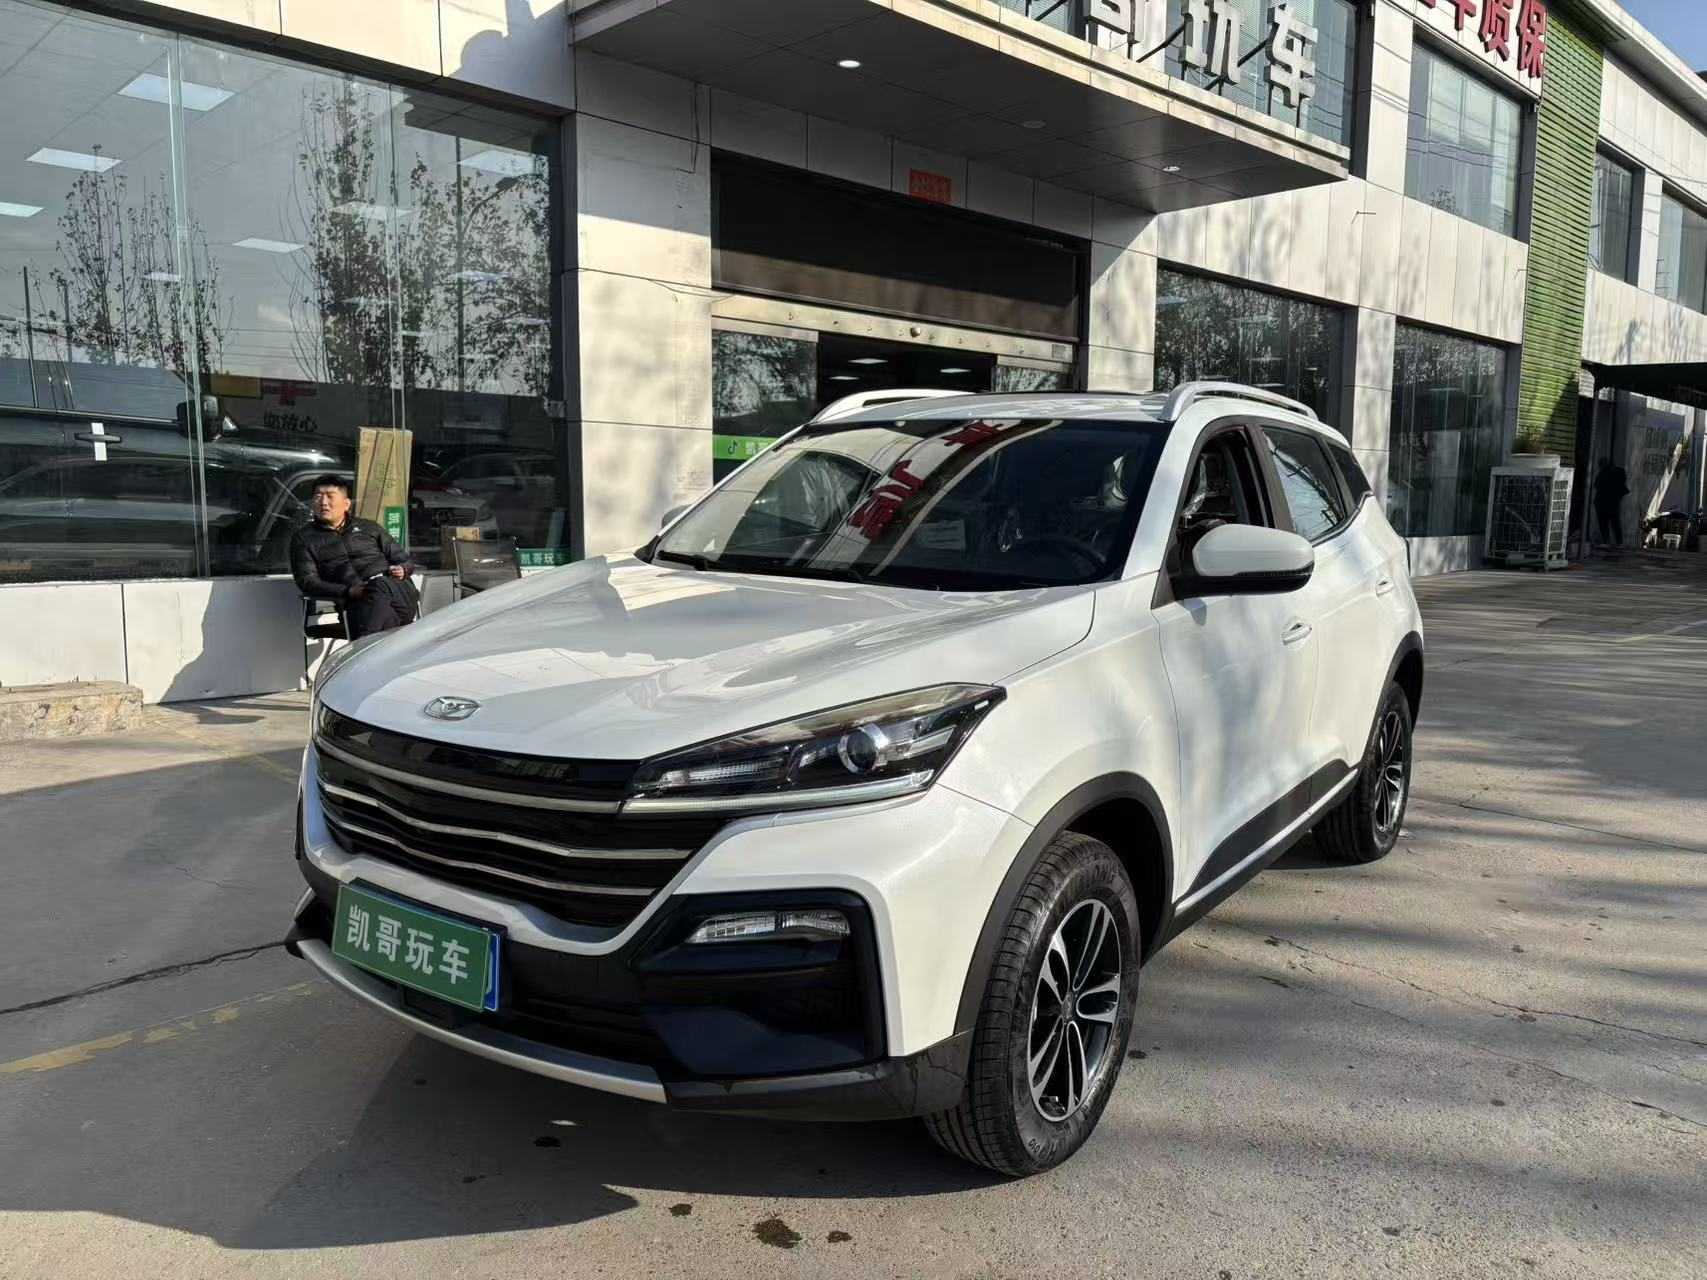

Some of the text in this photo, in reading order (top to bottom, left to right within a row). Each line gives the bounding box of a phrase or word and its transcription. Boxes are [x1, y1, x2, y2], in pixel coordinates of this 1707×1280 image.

[1416, 0, 1548, 78] 质保
[346, 904, 470, 985] 凯哥玩车
